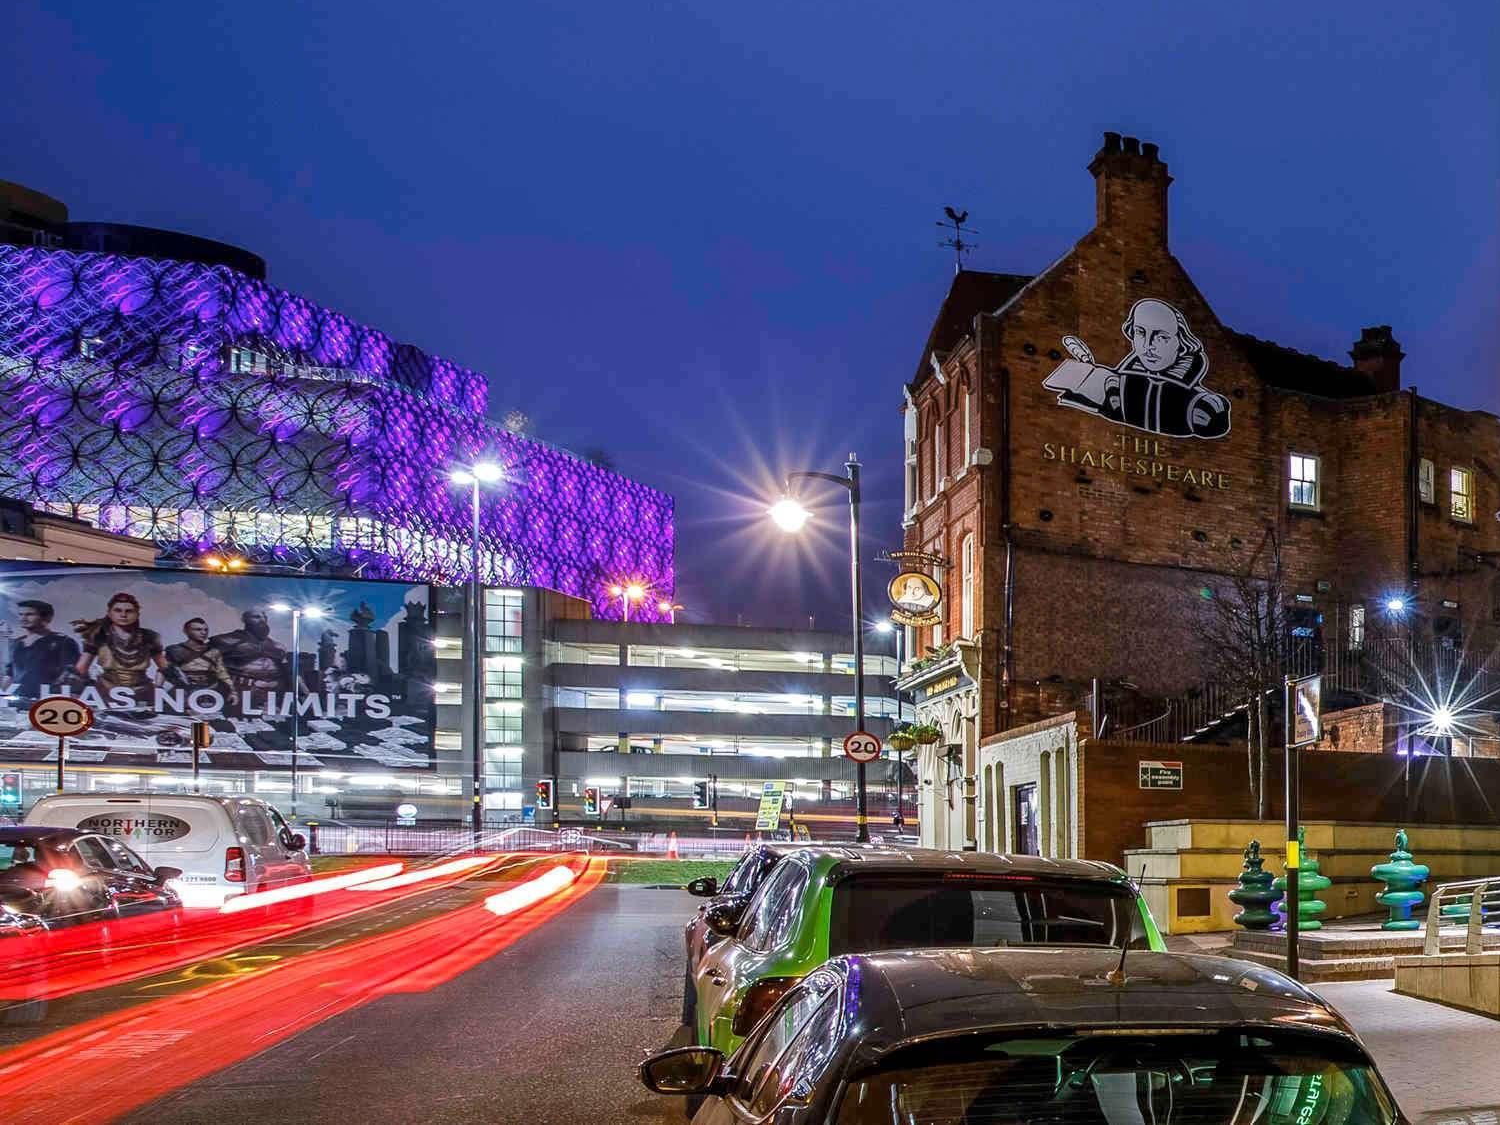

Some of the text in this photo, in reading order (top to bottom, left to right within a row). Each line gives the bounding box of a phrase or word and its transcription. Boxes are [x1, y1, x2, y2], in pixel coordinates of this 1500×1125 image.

[1117, 434, 1166, 457] THE
[1043, 442, 1233, 490] SHAKESPEARE
[39, 683, 137, 710] HAS
[154, 687, 225, 714] NO
[39, 709, 84, 725] 20
[850, 740, 876, 755] 20
[88, 818, 180, 828] NORTHERN
